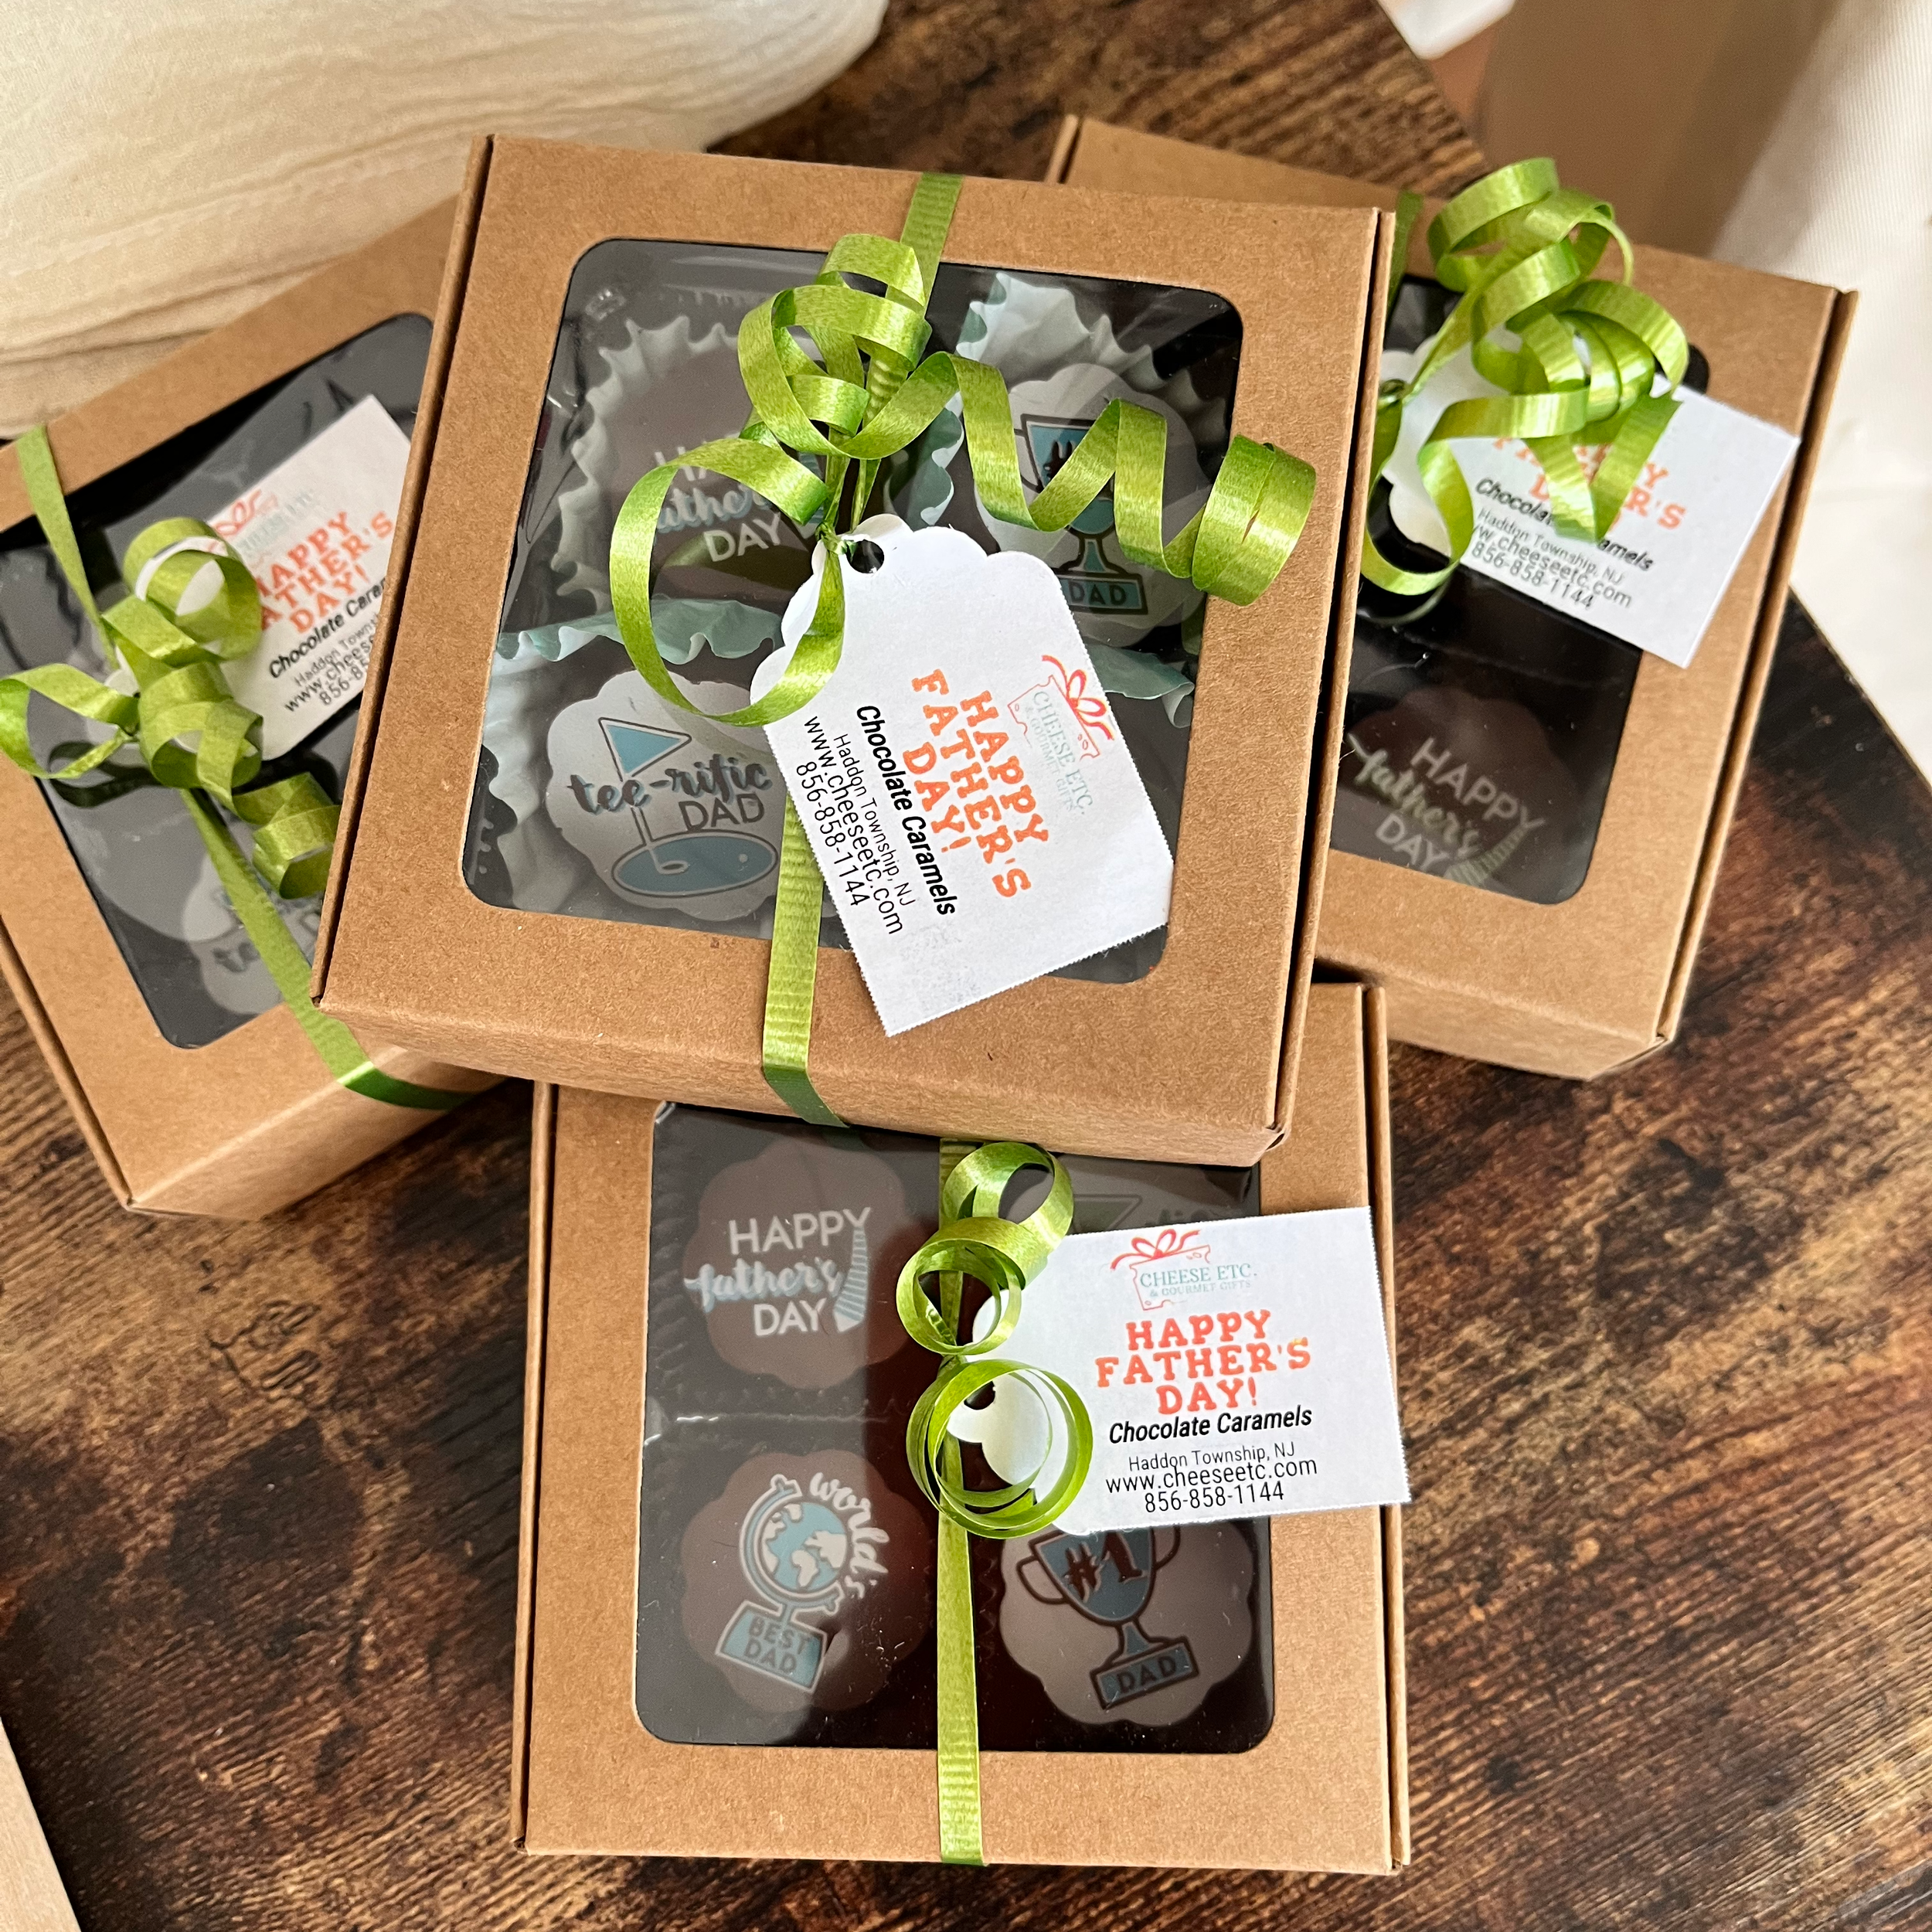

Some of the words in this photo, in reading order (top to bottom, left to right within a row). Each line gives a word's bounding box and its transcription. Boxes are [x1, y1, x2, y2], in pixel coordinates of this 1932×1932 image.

[703, 512, 781, 562] DAY
[1478, 508, 1530, 543] Haddon
[1602, 566, 1624, 586] NJ
[1597, 539, 1653, 571] amels
[262, 511, 393, 631] ATHER'S
[1471, 524, 1632, 609] w.cheeseetc.com
[1471, 541, 1594, 609] 856-858-1144
[1068, 584, 1127, 606] DAD
[270, 614, 345, 679] Chocolate
[294, 648, 341, 687] Haddon
[961, 690, 1049, 844] HAPPY
[1034, 691, 1075, 767] CHEESE
[1066, 769, 1094, 815] ETC.
[567, 753, 773, 815] tee-rific
[903, 743, 971, 853] DAY!
[912, 669, 1032, 897] FATHER'S
[1410, 737, 1546, 830] HAPPY
[679, 793, 765, 832] DAD
[796, 761, 870, 906] 856-858-1144
[804, 716, 903, 934] www.cheeseetc.com
[834, 733, 867, 797] Haddon
[861, 798, 900, 882] Township,
[894, 882, 916, 906] NJ
[856, 706, 913, 811] Chocolate
[902, 816, 957, 915] Caramels
[1376, 813, 1451, 872] DAY
[729, 1206, 872, 1256] HAPPY
[1140, 1267, 1211, 1288] CHEESE
[1216, 1264, 1257, 1281] ETC.
[1162, 1283, 1216, 1296] GOURMET
[1219, 1280, 1251, 1291] GIFTS
[753, 1298, 828, 1338] DAY
[1125, 1309, 1271, 1351] HAPPY
[1095, 1336, 1311, 1388] FATHER'S
[1155, 1376, 1258, 1415] DAY!
[1109, 1416, 1211, 1444] Chocolate
[1216, 1404, 1313, 1434] Caramels
[1105, 1458, 1318, 1494] www.cheeseetc.com
[1129, 1451, 1188, 1471] Haddon
[1192, 1445, 1270, 1467] Township,
[1274, 1441, 1295, 1458] NJ
[1145, 1480, 1284, 1513] 856-858-1144
[743, 1638, 798, 1674] DAD
[748, 1617, 811, 1656] BEST
[1116, 1656, 1177, 1693] DAD
